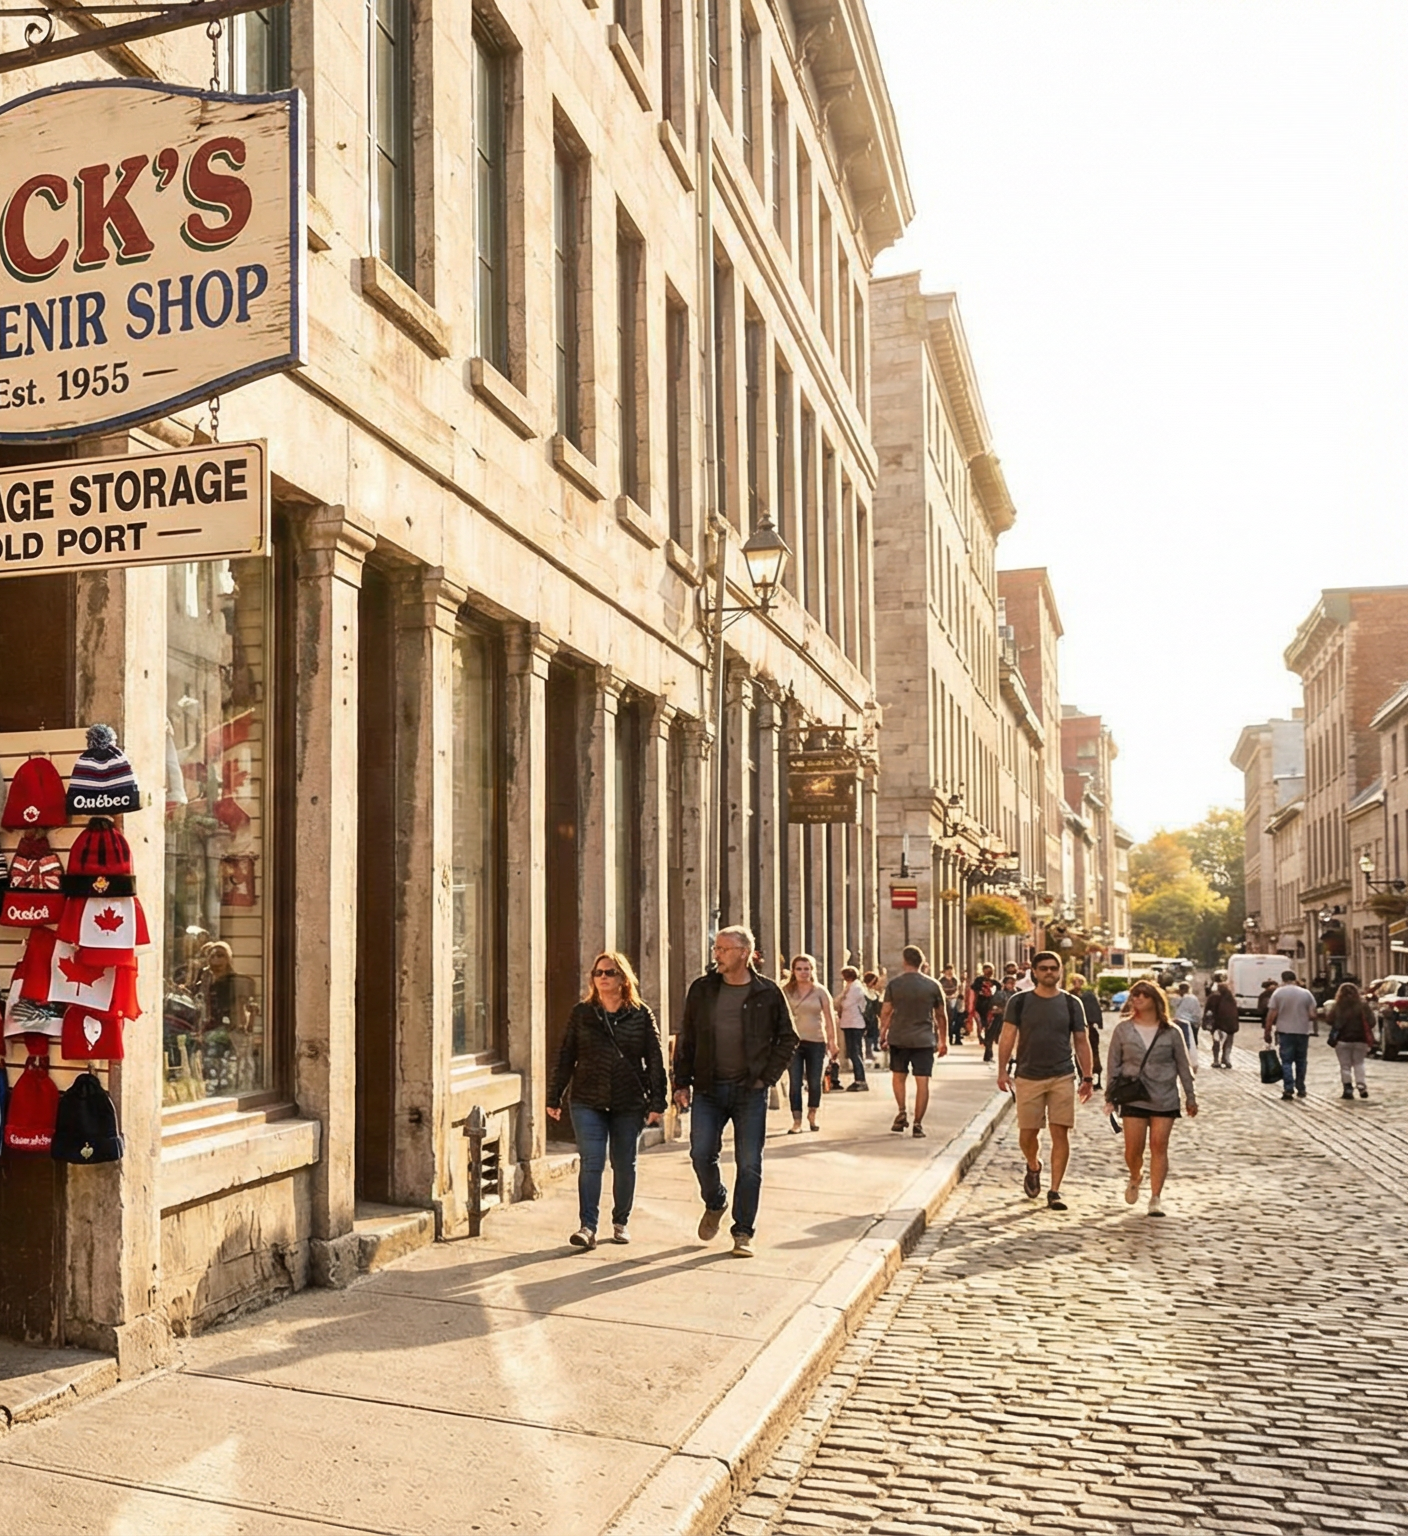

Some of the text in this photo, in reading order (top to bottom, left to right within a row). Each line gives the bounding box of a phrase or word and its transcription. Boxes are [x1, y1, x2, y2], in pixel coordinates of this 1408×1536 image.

[125, 263, 269, 340] SHOP
[57, 361, 130, 402] 1955
[68, 459, 248, 517] STORAGE
[57, 522, 148, 557] PORT
